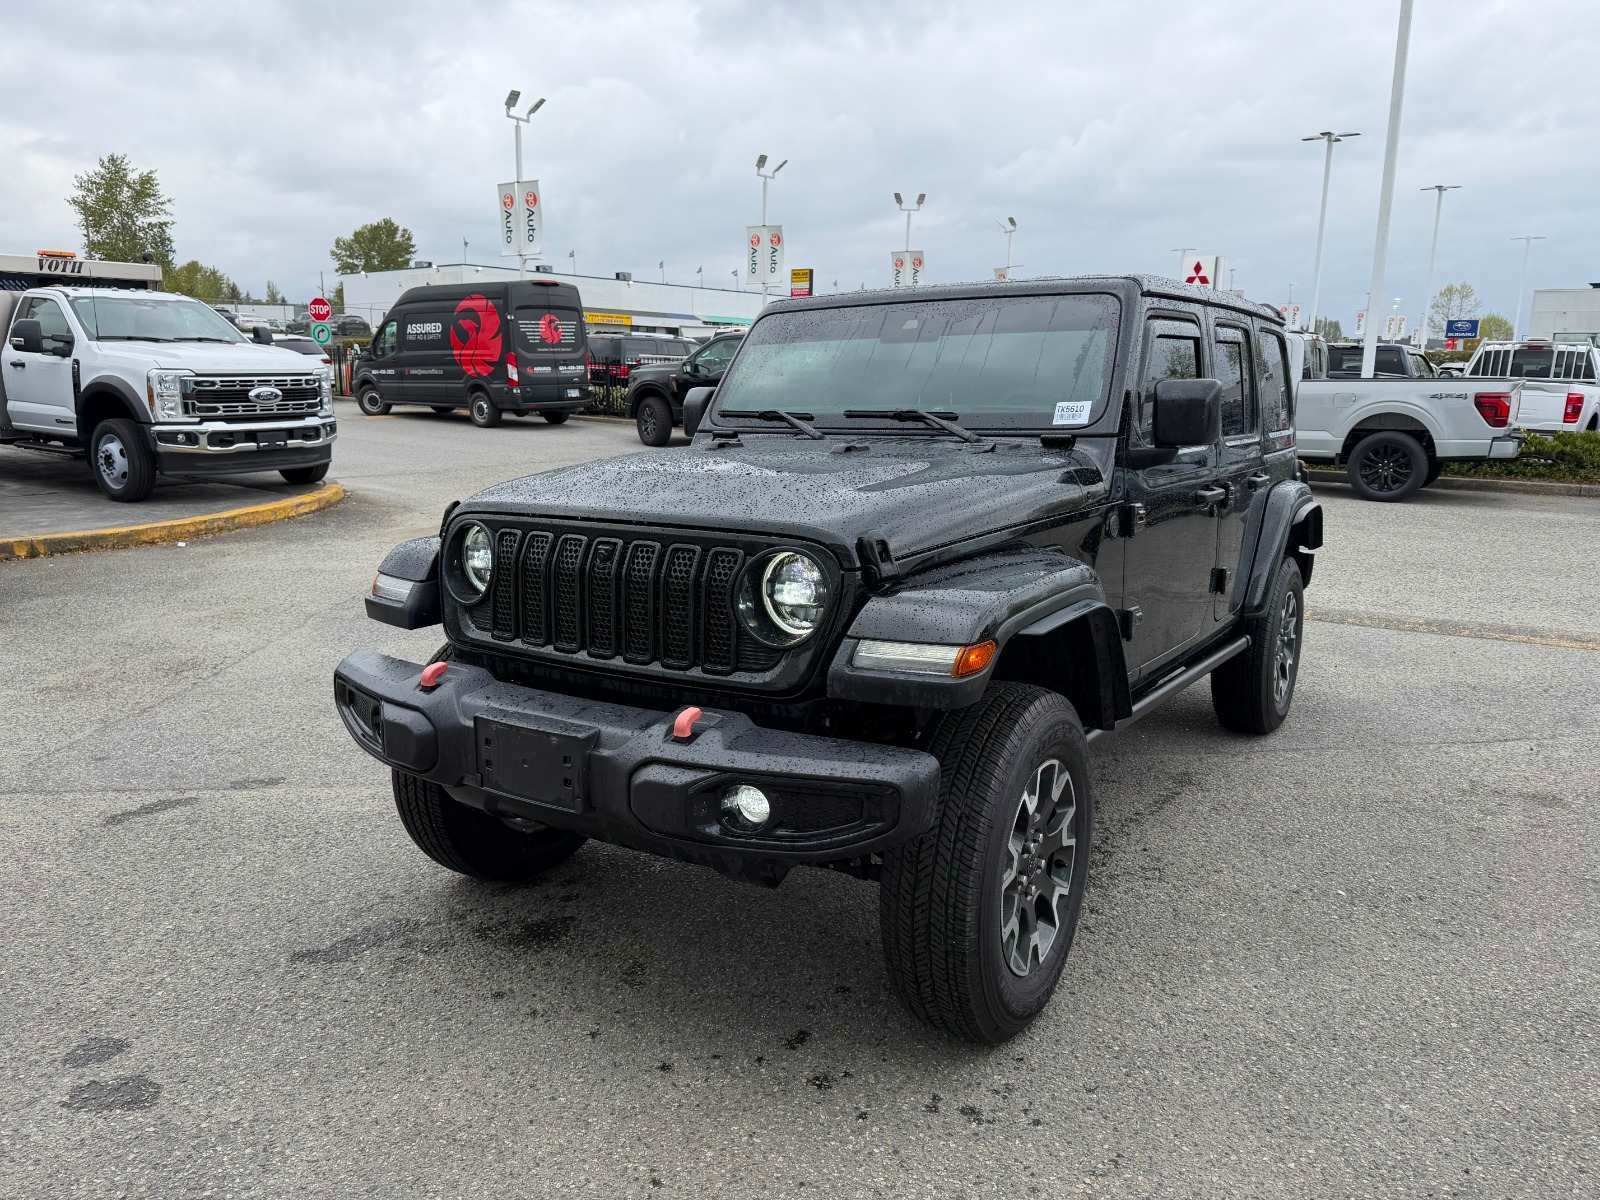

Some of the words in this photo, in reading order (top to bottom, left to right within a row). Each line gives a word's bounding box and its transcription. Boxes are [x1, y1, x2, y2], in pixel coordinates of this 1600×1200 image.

[504, 210, 513, 244] Auto
[526, 208, 536, 242] Auto
[38, 258, 83, 273] VOTH
[770, 247, 778, 273] Auto
[310, 304, 329, 314] STOP
[406, 322, 442, 334] ASSURED
